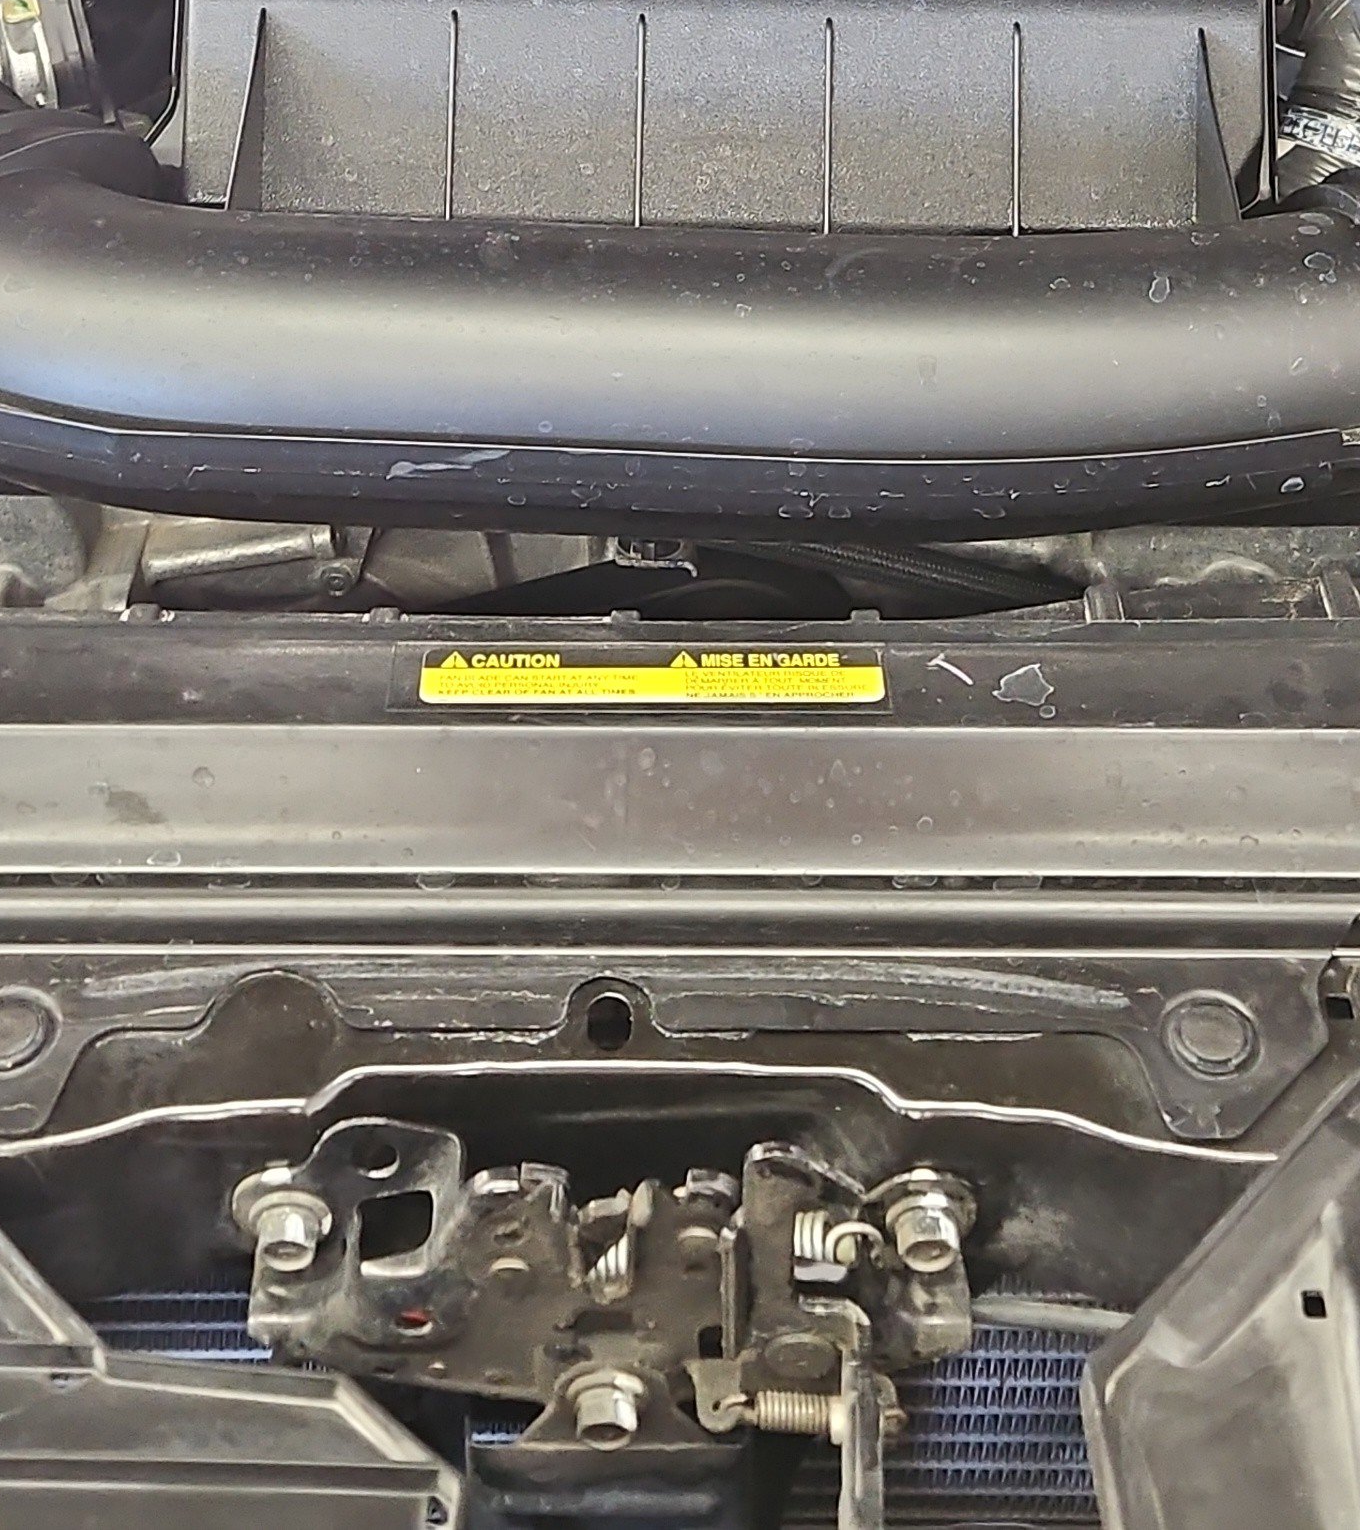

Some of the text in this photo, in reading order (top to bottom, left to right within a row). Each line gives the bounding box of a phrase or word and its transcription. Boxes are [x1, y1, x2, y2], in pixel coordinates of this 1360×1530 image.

[471, 653, 561, 668] CAUTION
[700, 653, 841, 668] MISE EN GARDE
